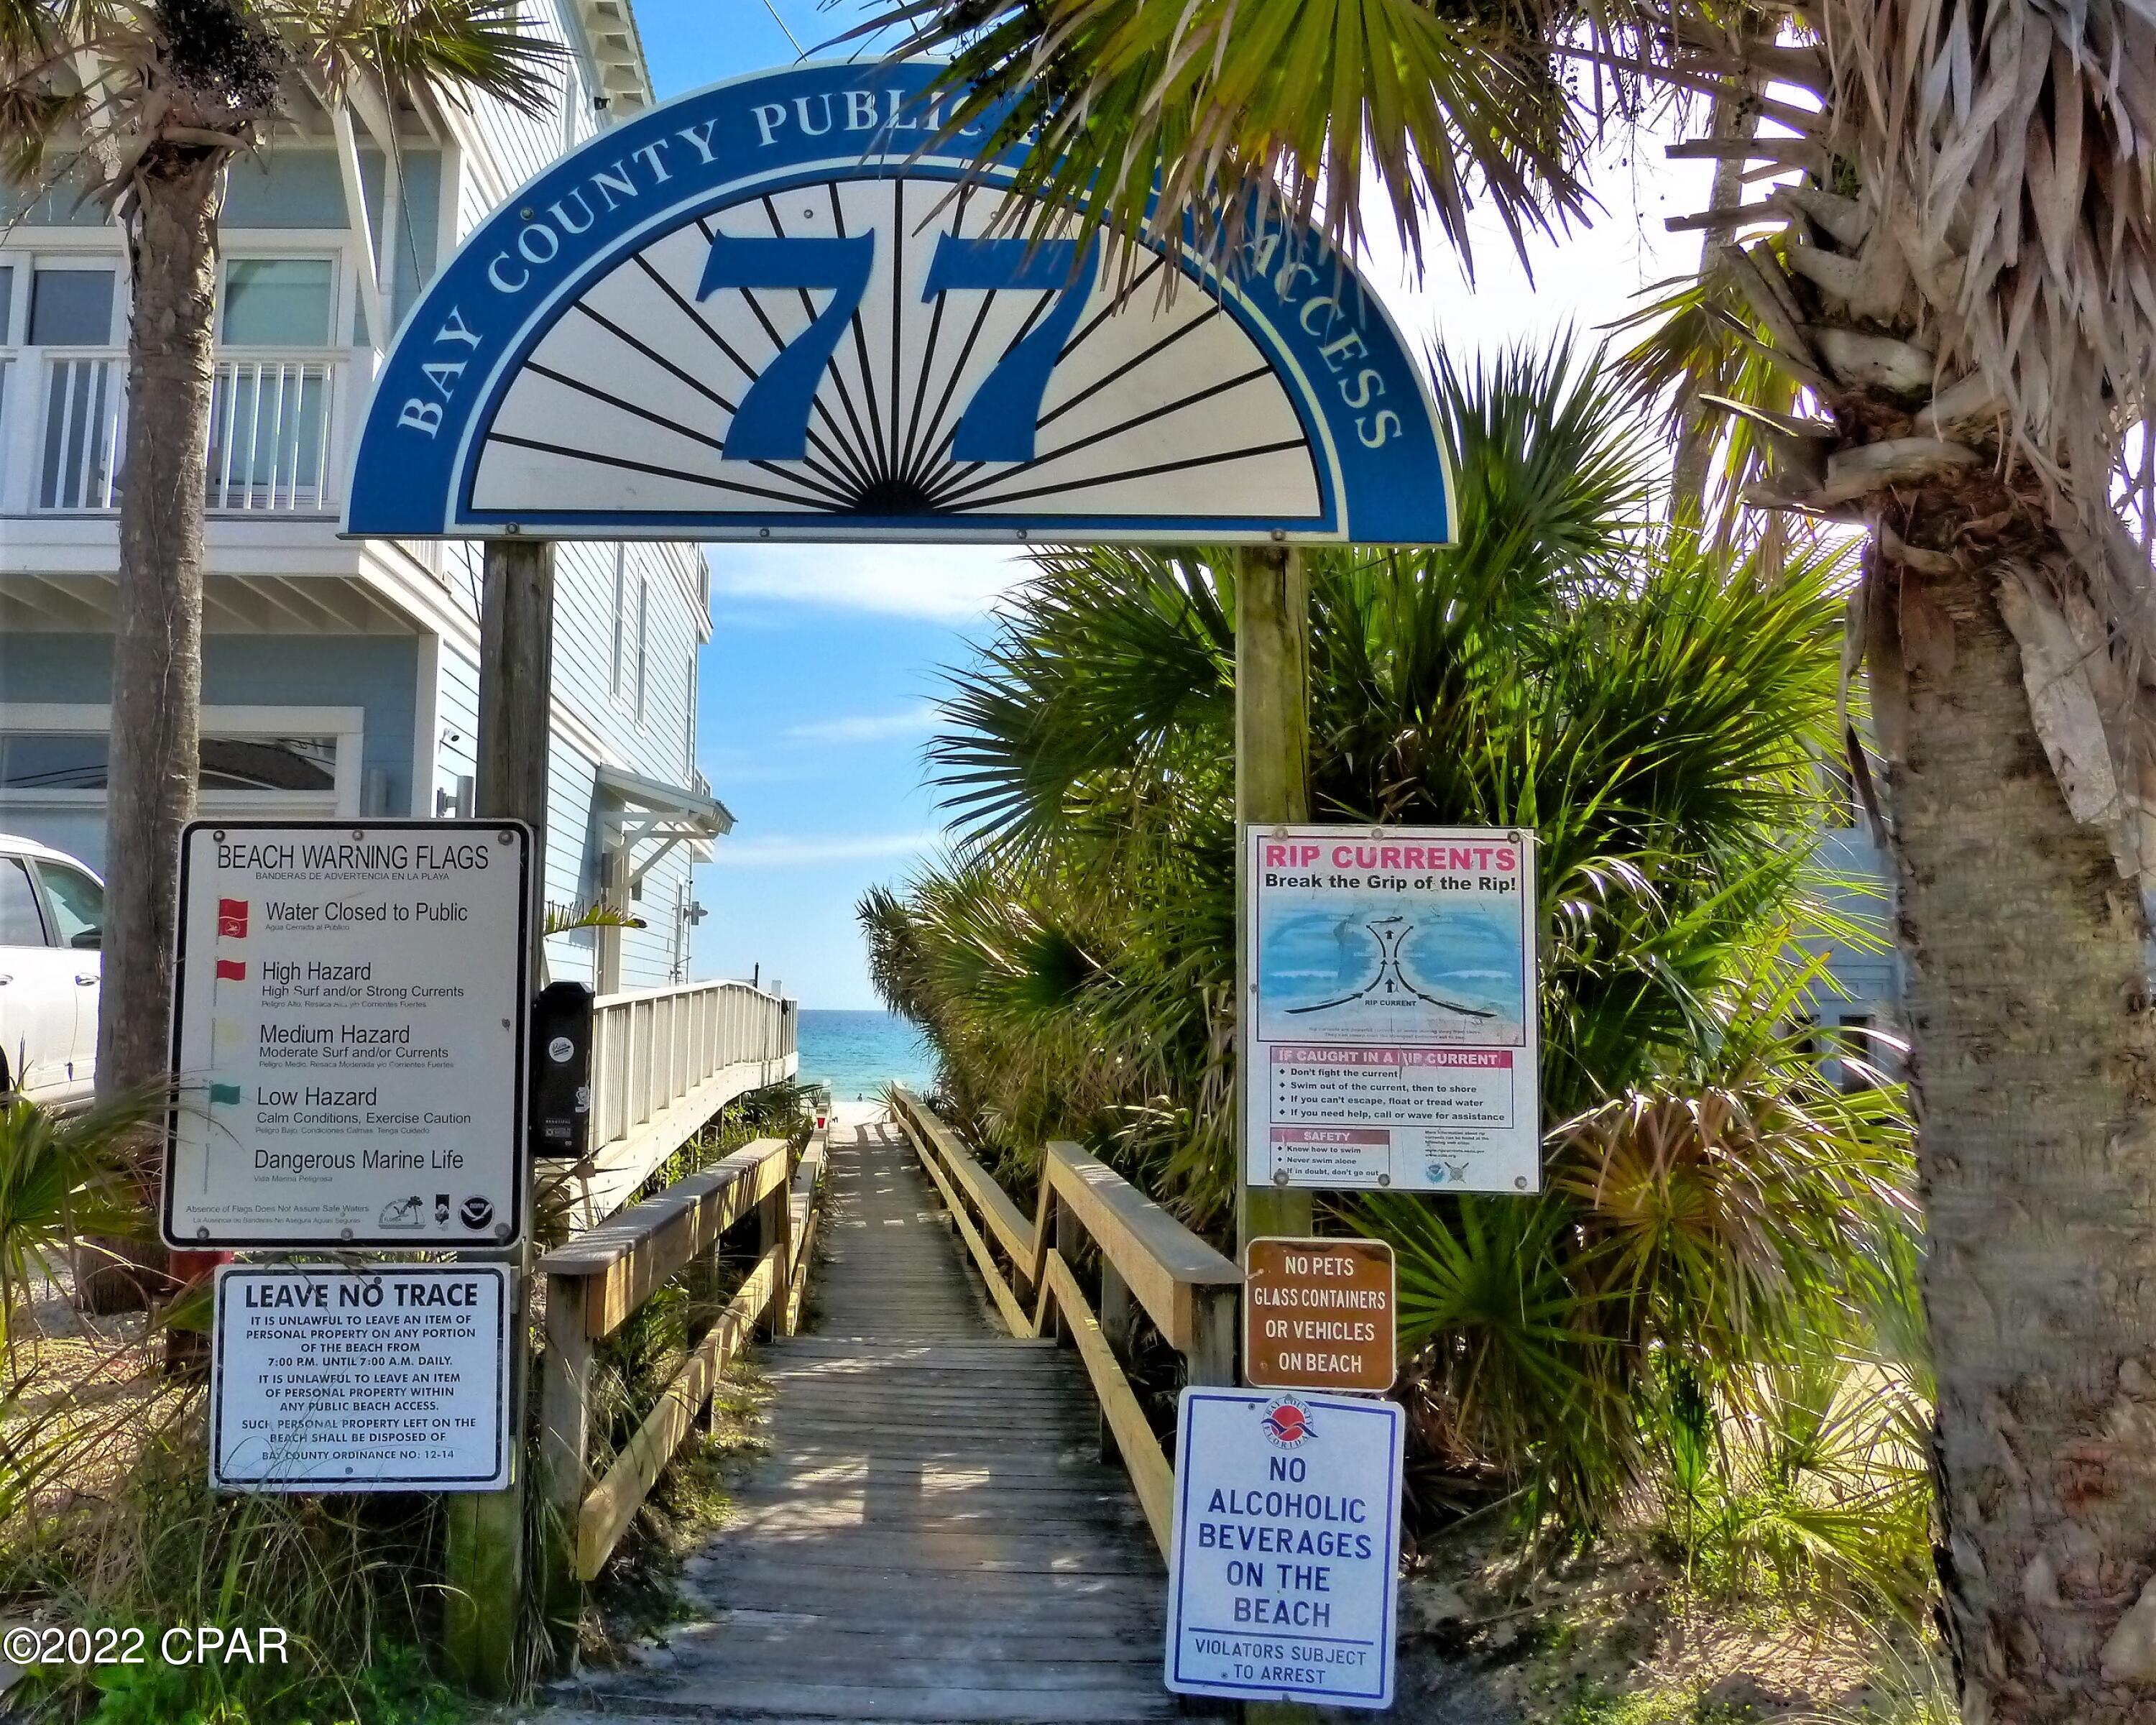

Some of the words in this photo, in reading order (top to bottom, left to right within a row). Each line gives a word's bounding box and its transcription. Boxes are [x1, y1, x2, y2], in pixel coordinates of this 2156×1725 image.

[397, 305, 483, 440] BAY
[487, 119, 720, 295] COUNTY
[1233, 229, 1403, 450] ACCESS
[695, 227, 1101, 461] 77
[218, 845, 293, 868] BEACH
[302, 845, 407, 869] WARNING
[416, 845, 488, 869] FLAGS
[1266, 845, 1319, 867] RIP
[1332, 846, 1515, 870] CURRENTS
[1266, 873, 1322, 887] Break
[1328, 874, 1360, 888] the
[1367, 875, 1406, 892] Grip
[1414, 875, 1432, 890] of
[1439, 876, 1471, 890] the
[1478, 877, 1515, 893] Rip!
[266, 902, 318, 920] Water
[325, 901, 386, 921] Closed
[393, 903, 408, 920] to
[416, 902, 467, 921] Public
[263, 962, 300, 985] High
[308, 962, 370, 981] Hazard
[262, 984, 288, 998] High
[294, 985, 319, 995] Surf
[323, 985, 362, 995] and/or
[367, 985, 406, 999] Strong
[411, 985, 464, 996] Currents
[260, 1024, 333, 1043] Medium
[341, 1024, 409, 1043] Hazard
[259, 1046, 318, 1057] Moderate
[323, 1046, 349, 1057] Surf
[352, 1046, 391, 1057] and/or
[395, 1046, 448, 1057] Currents
[1297, 1050, 1358, 1063] CAUGHT
[1363, 1052, 1378, 1062] IN
[1383, 1052, 1393, 1063] A
[1428, 1054, 1497, 1066] CURRENT
[1318, 1069, 1340, 1077] fight
[257, 1086, 298, 1105] Low
[305, 1087, 376, 1105] Hazard
[257, 1112, 288, 1123] Calm
[293, 1112, 360, 1124] Conditions,
[366, 1112, 419, 1123] Exercise
[423, 1112, 470, 1123] Caution
[1348, 1109, 1370, 1119] help,
[1304, 1131, 1350, 1141] SAFETY
[255, 1149, 354, 1173] Dangerous
[363, 1149, 424, 1168] Marine
[432, 1149, 463, 1168] Life
[1286, 1256, 1307, 1274] NO
[1313, 1257, 1353, 1276] PETS
[246, 1284, 328, 1308] LEAVE
[339, 1284, 383, 1307] NO
[394, 1283, 477, 1306] TRACE
[1254, 1287, 1297, 1306] GLASS
[1302, 1289, 1385, 1310] CONTAINERS
[251, 1316, 260, 1325] IT
[264, 1316, 274, 1325] IS
[279, 1315, 342, 1325] UNLAWFUL
[346, 1316, 361, 1325] TO
[366, 1315, 399, 1324] LEAVE
[403, 1315, 420, 1324] AN
[425, 1315, 451, 1324] ITEM
[456, 1315, 471, 1323] OF
[1266, 1320, 1287, 1338] OR
[1293, 1320, 1374, 1340] VEHICLES
[246, 1330, 306, 1338] PERSONAL
[310, 1329, 367, 1338] PROPERTY
[372, 1329, 390, 1338] ON
[394, 1329, 418, 1338] ANY
[423, 1328, 474, 1337] PORTION
[300, 1343, 316, 1352] OF
[320, 1343, 341, 1352] THE
[346, 1343, 382, 1352] BEACH
[387, 1343, 420, 1351] FROM
[268, 1357, 292, 1366] 7:00
[297, 1357, 317, 1366] P.M.
[322, 1357, 356, 1366] UNTIL
[359, 1356, 384, 1366] 7:00
[389, 1356, 413, 1365] A.M.
[418, 1356, 451, 1365] DAILY.
[1279, 1352, 1301, 1370] ON
[1306, 1353, 1361, 1373] BEACH
[259, 1374, 268, 1383] IT
[272, 1374, 282, 1383] IS
[287, 1374, 351, 1384] UNLAWFUL
[354, 1374, 369, 1383] TO
[374, 1374, 407, 1382] LEAVE
[412, 1374, 428, 1382] AN
[434, 1374, 459, 1382] ITEM
[265, 1389, 280, 1397] OF
[285, 1388, 345, 1397] PERSONAL
[349, 1387, 406, 1397] PROPERTY
[410, 1387, 453, 1396] WITHIN
[280, 1402, 304, 1411] ANY
[308, 1402, 349, 1411] PUBLIC
[353, 1402, 390, 1410] BEACH
[394, 1401, 438, 1409] ACCESS.
[312, 1433, 347, 1442] SHALL
[351, 1433, 364, 1442] BE
[369, 1432, 425, 1441] DISPOSED
[430, 1432, 445, 1441] OF
[1270, 1456, 1305, 1482] NO
[1207, 1489, 1365, 1523] ALCOHOLIC
[1199, 1522, 1370, 1559] BEVERAGES
[1227, 1560, 1263, 1587] ON
[1276, 1563, 1330, 1591] THE
[1234, 1597, 1330, 1627] BEACH
[1195, 1638, 1283, 1659] VIOLATORS
[1291, 1646, 1366, 1665] SUBJECT
[1233, 1663, 1253, 1679] TO
[1261, 1666, 1325, 1683] ARREST
